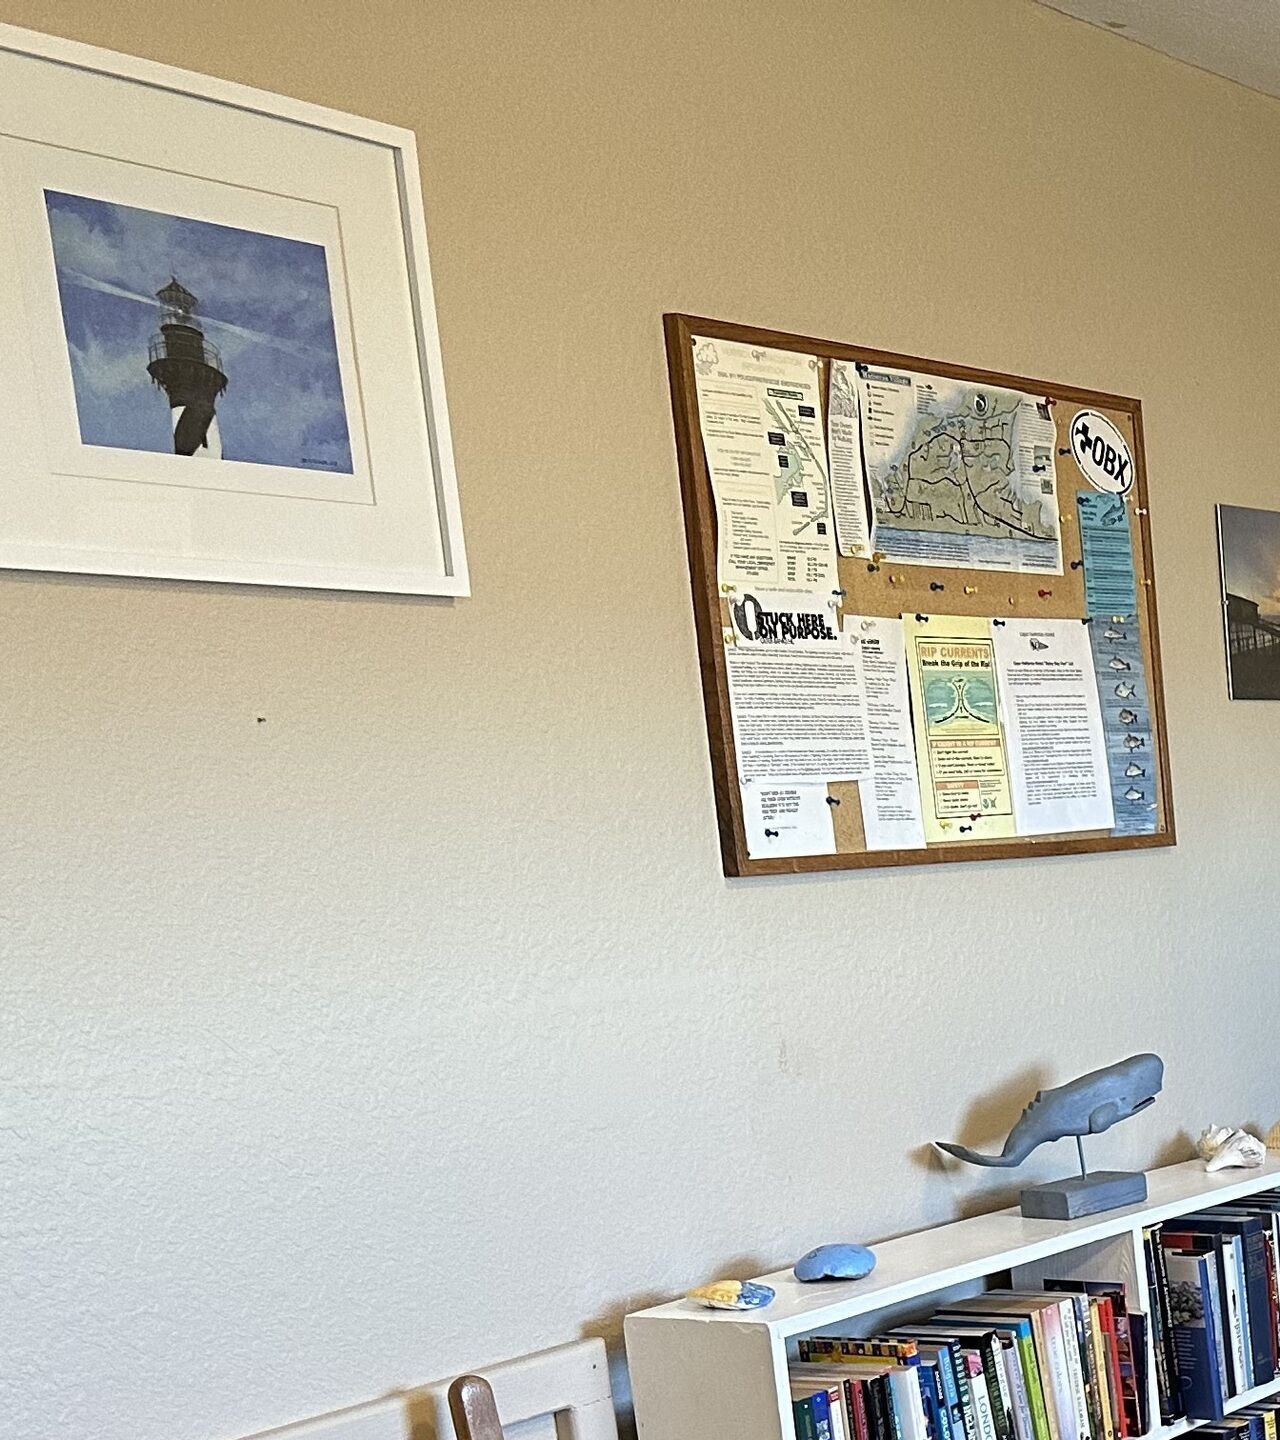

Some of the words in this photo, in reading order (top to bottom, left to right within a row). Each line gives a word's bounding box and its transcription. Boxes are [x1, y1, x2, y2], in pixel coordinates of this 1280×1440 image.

[1091, 437, 1129, 487] OBX
[756, 612, 793, 627] STUCK
[797, 613, 824, 627] HERE
[759, 625, 777, 639] ON
[781, 626, 838, 640] PURPOSE.
[921, 647, 937, 657] RIP
[940, 647, 989, 659] CURRENTS
[943, 1357, 956, 1398] Bulgaria
